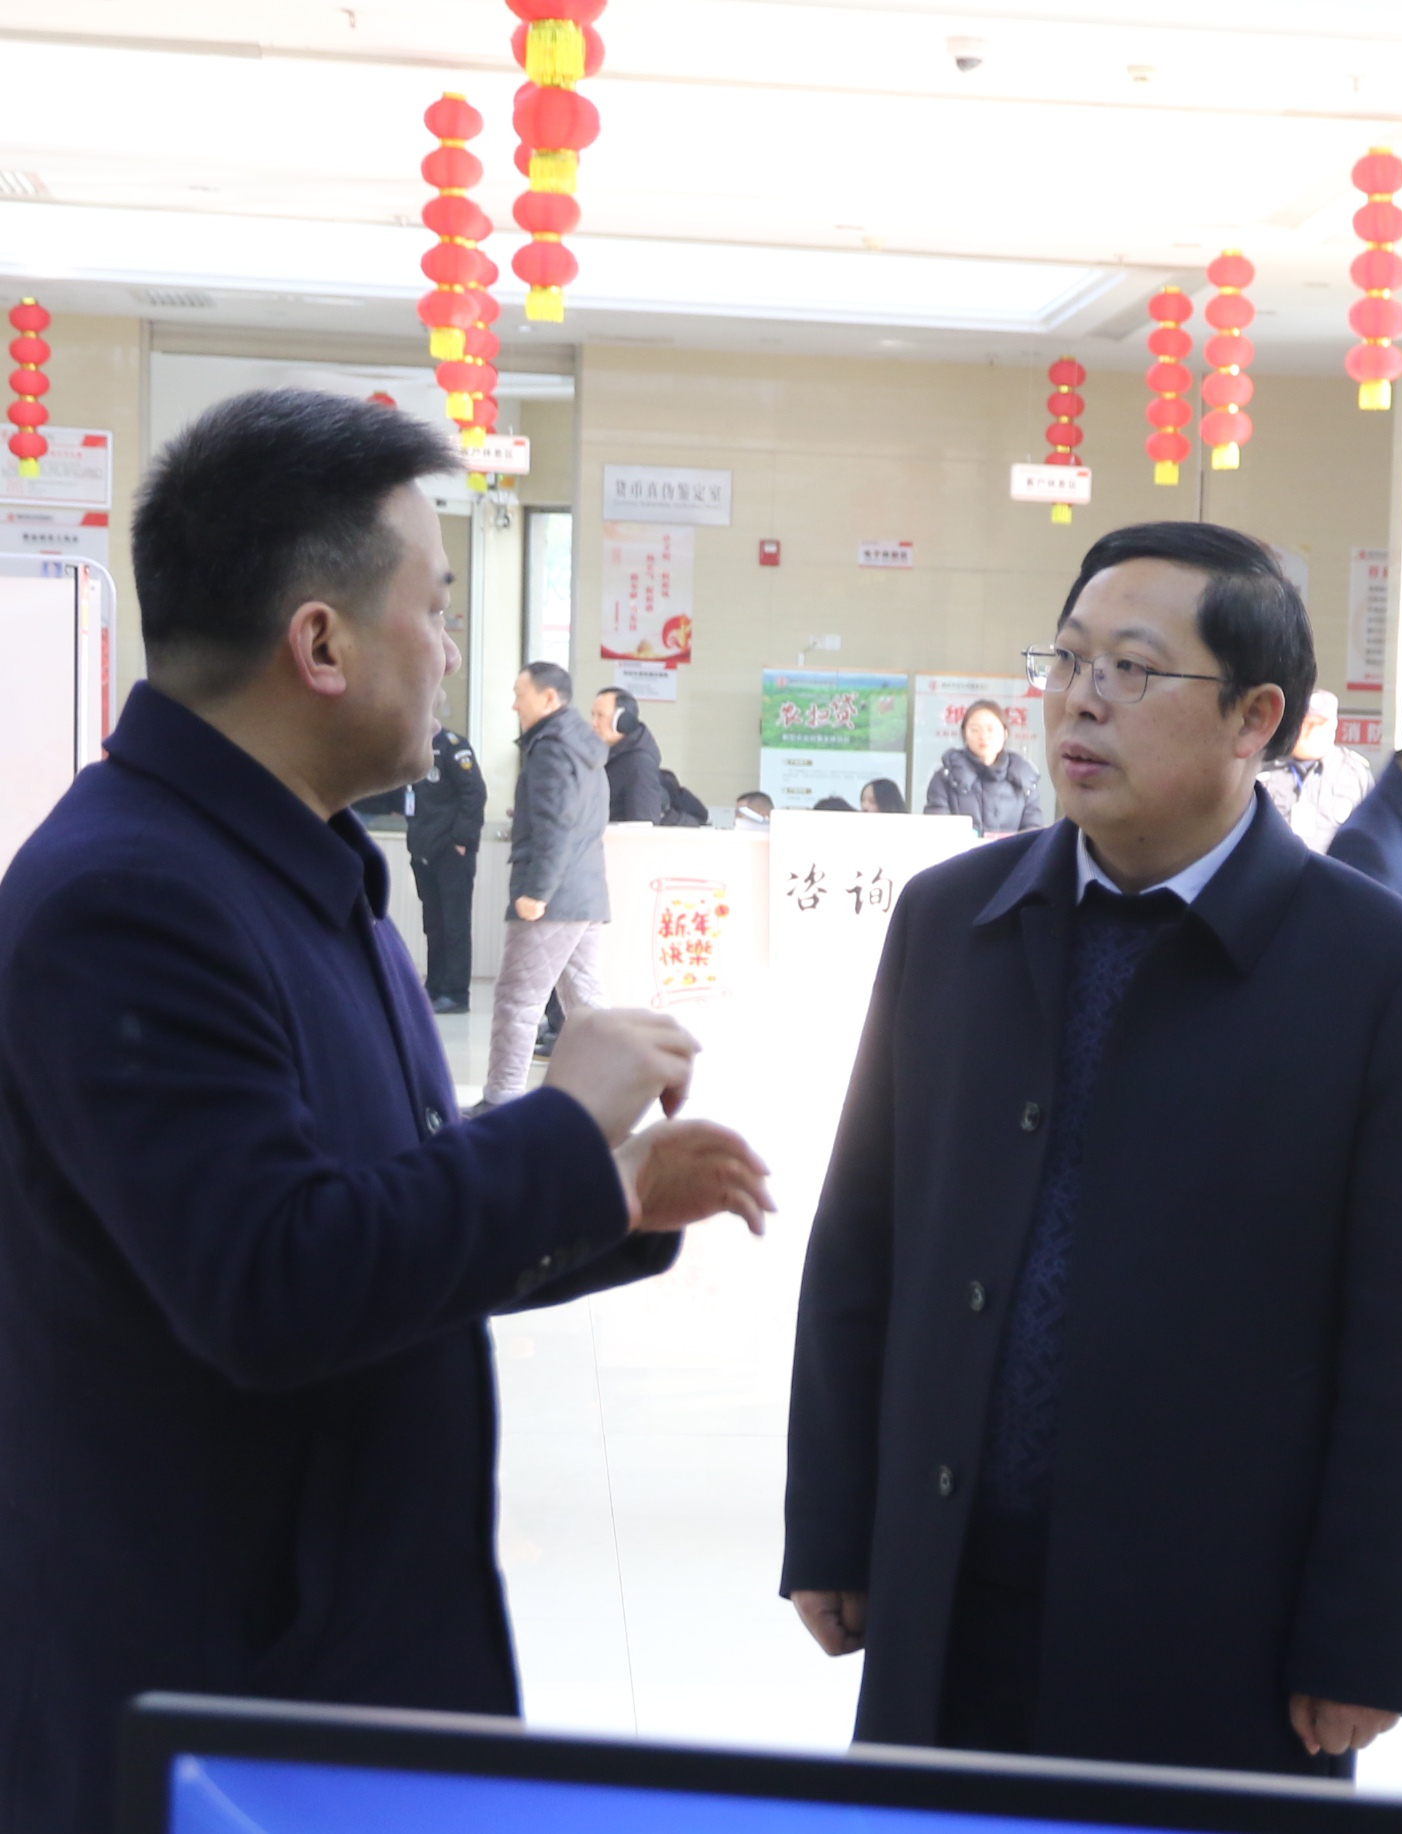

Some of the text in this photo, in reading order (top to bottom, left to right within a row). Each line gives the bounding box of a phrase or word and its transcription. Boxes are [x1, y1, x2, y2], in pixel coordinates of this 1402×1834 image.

[787, 863, 894, 915] 咨询
[657, 908, 711, 938] 新年
[659, 939, 713, 966] 快樂
